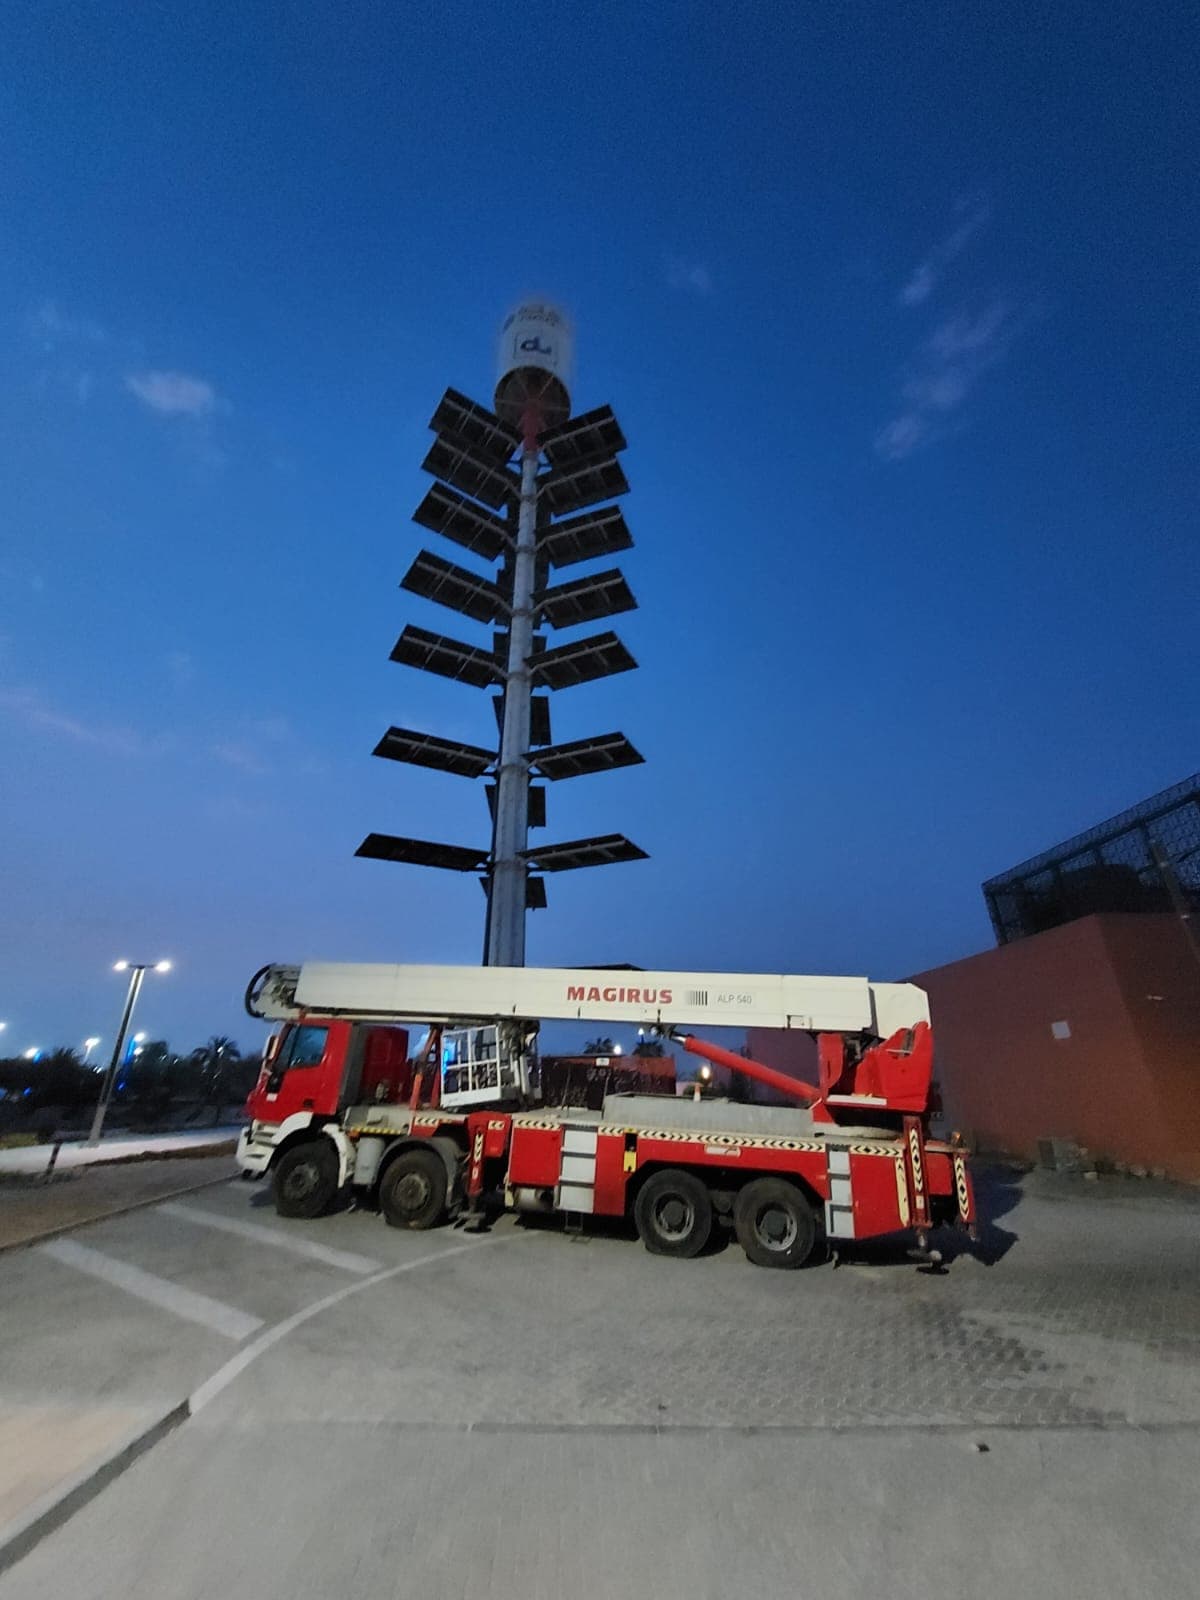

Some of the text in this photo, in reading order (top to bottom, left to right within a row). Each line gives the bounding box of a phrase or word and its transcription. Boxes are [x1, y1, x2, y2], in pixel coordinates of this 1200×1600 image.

[567, 986, 673, 1004] MAGIRUS
[717, 994, 752, 1005] ALP 540
